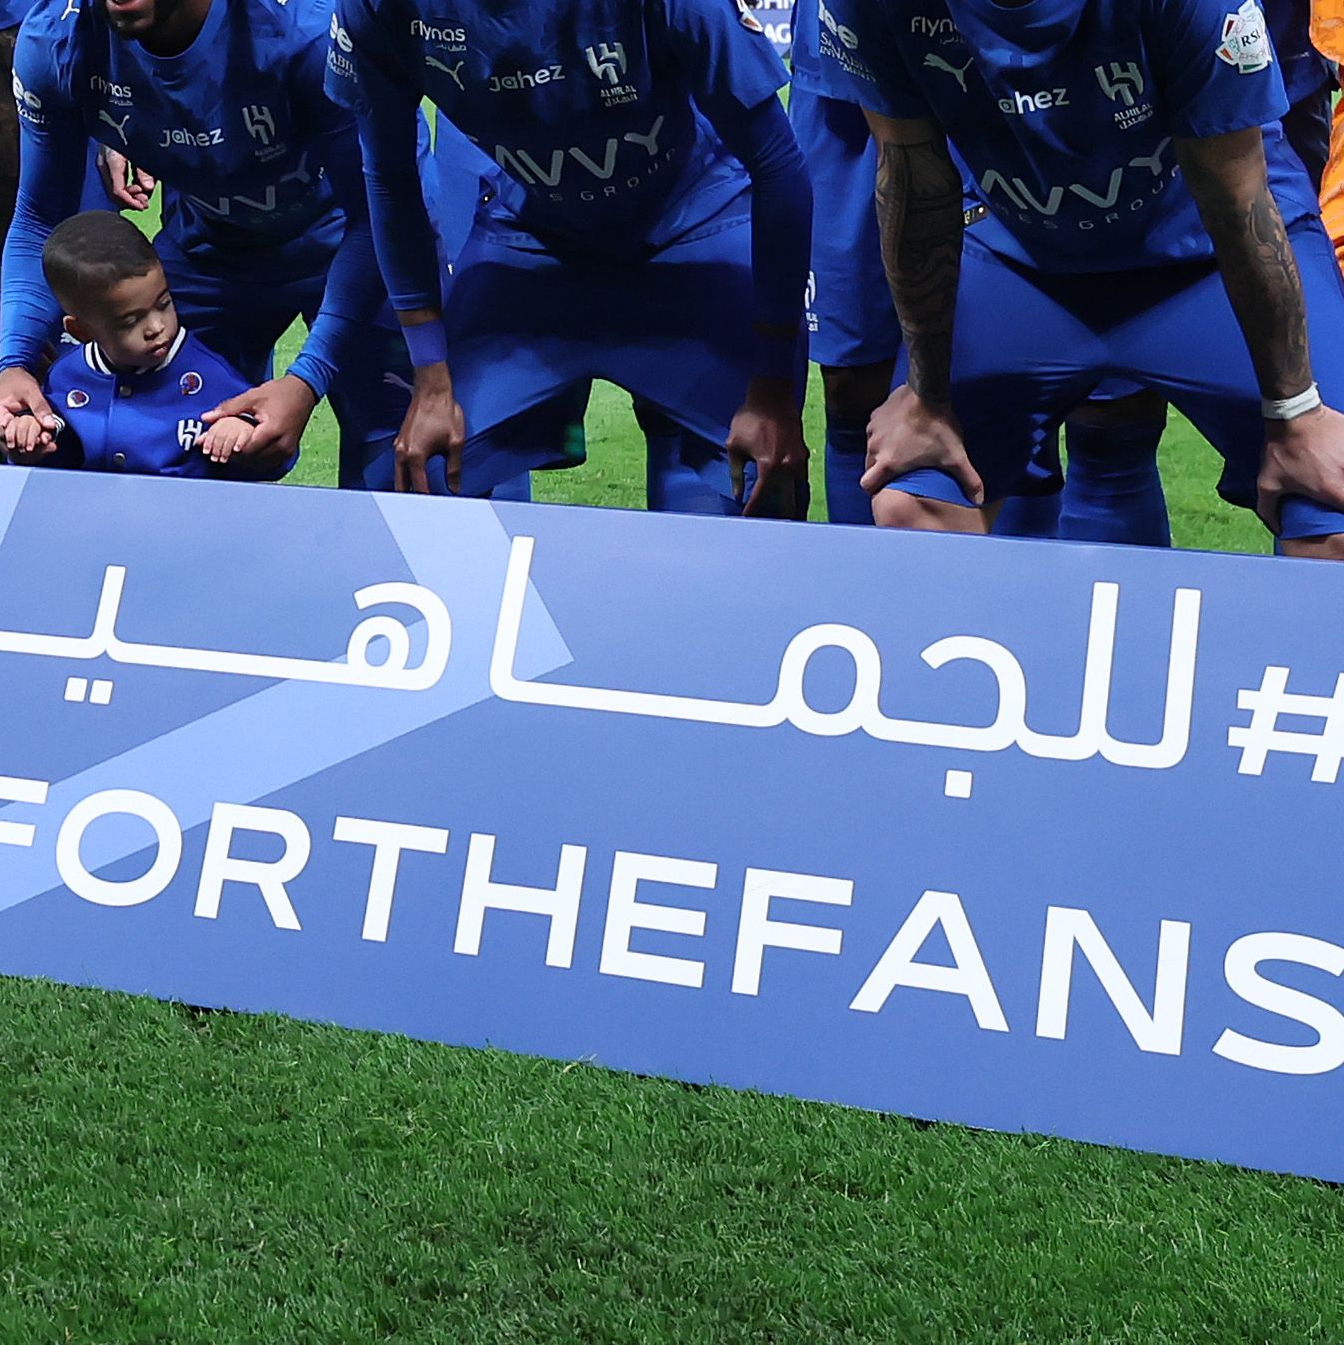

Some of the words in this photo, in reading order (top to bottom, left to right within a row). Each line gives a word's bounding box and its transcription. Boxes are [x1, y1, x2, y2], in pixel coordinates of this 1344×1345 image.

[411, 20, 466, 42] flynas
[912, 16, 957, 38] flyn
[999, 88, 1070, 114] ahez
[495, 115, 664, 187] AVVY
[981, 136, 1172, 215] AVVY
